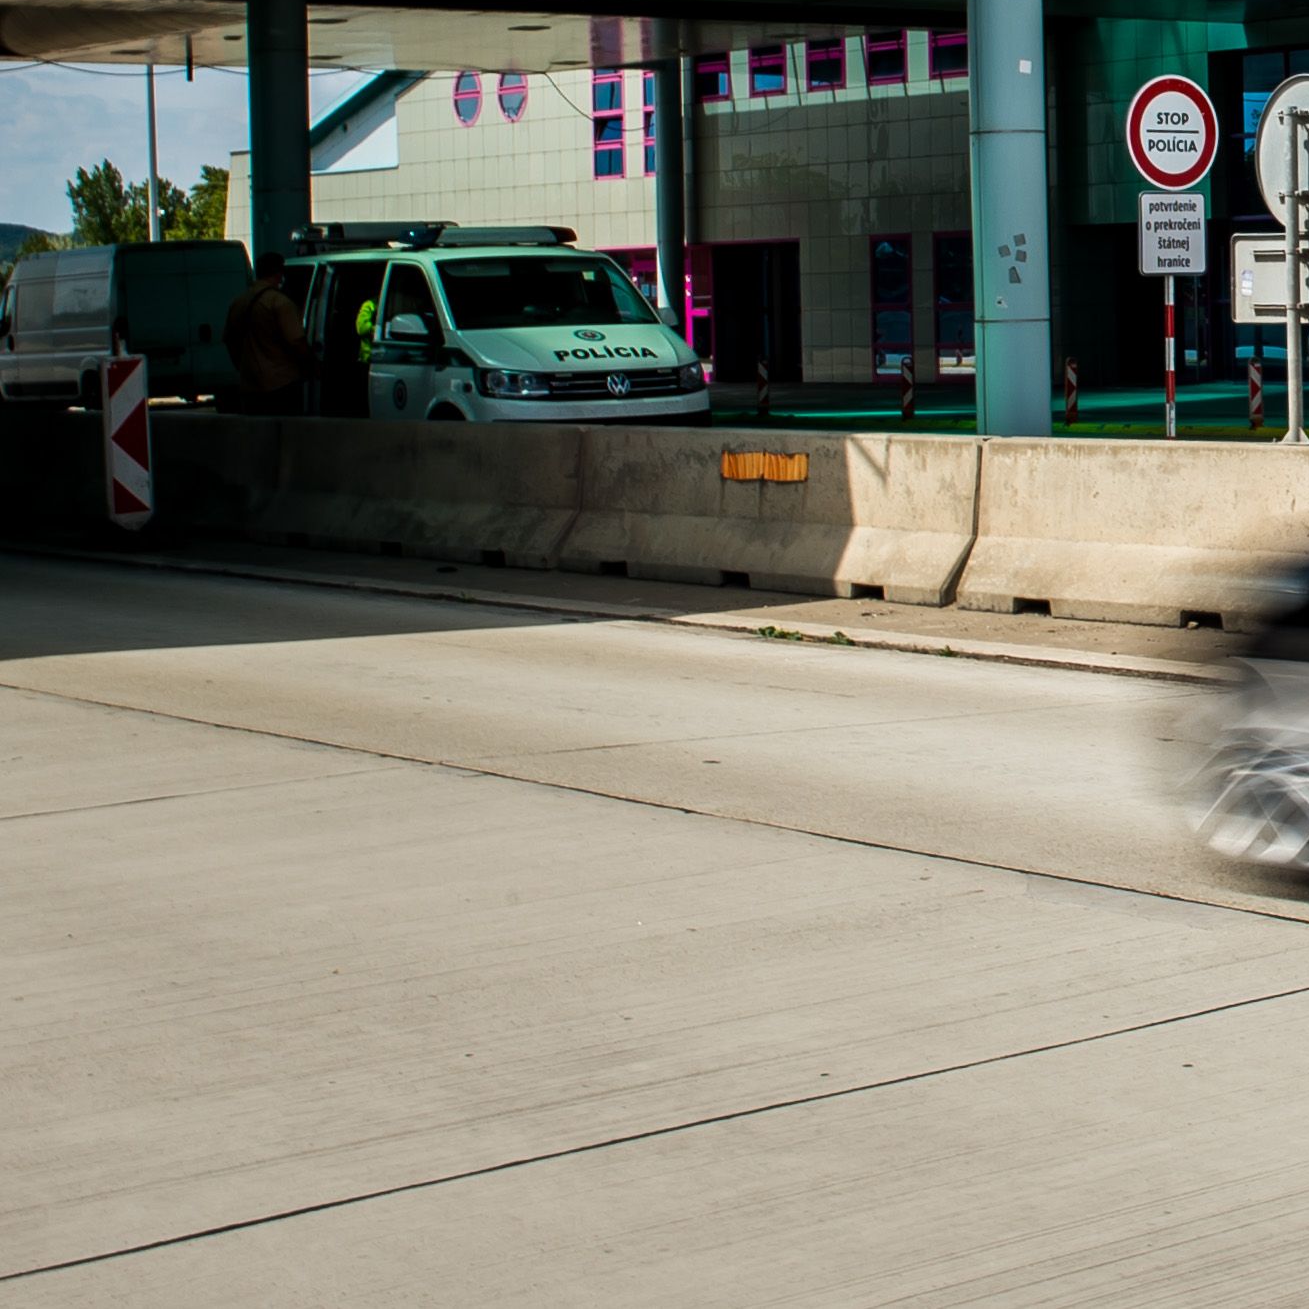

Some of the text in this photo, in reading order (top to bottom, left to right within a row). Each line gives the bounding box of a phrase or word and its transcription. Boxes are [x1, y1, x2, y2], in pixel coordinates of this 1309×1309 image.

[1156, 112, 1190, 125] STOP
[1147, 136, 1198, 153] POLÍCIA
[1149, 200, 1197, 214] potvrdenie
[1145, 221, 1152, 231] o
[1157, 236, 1190, 252] štátnej
[1157, 255, 1191, 268] hranice
[554, 346, 658, 362] POLÍCIA
